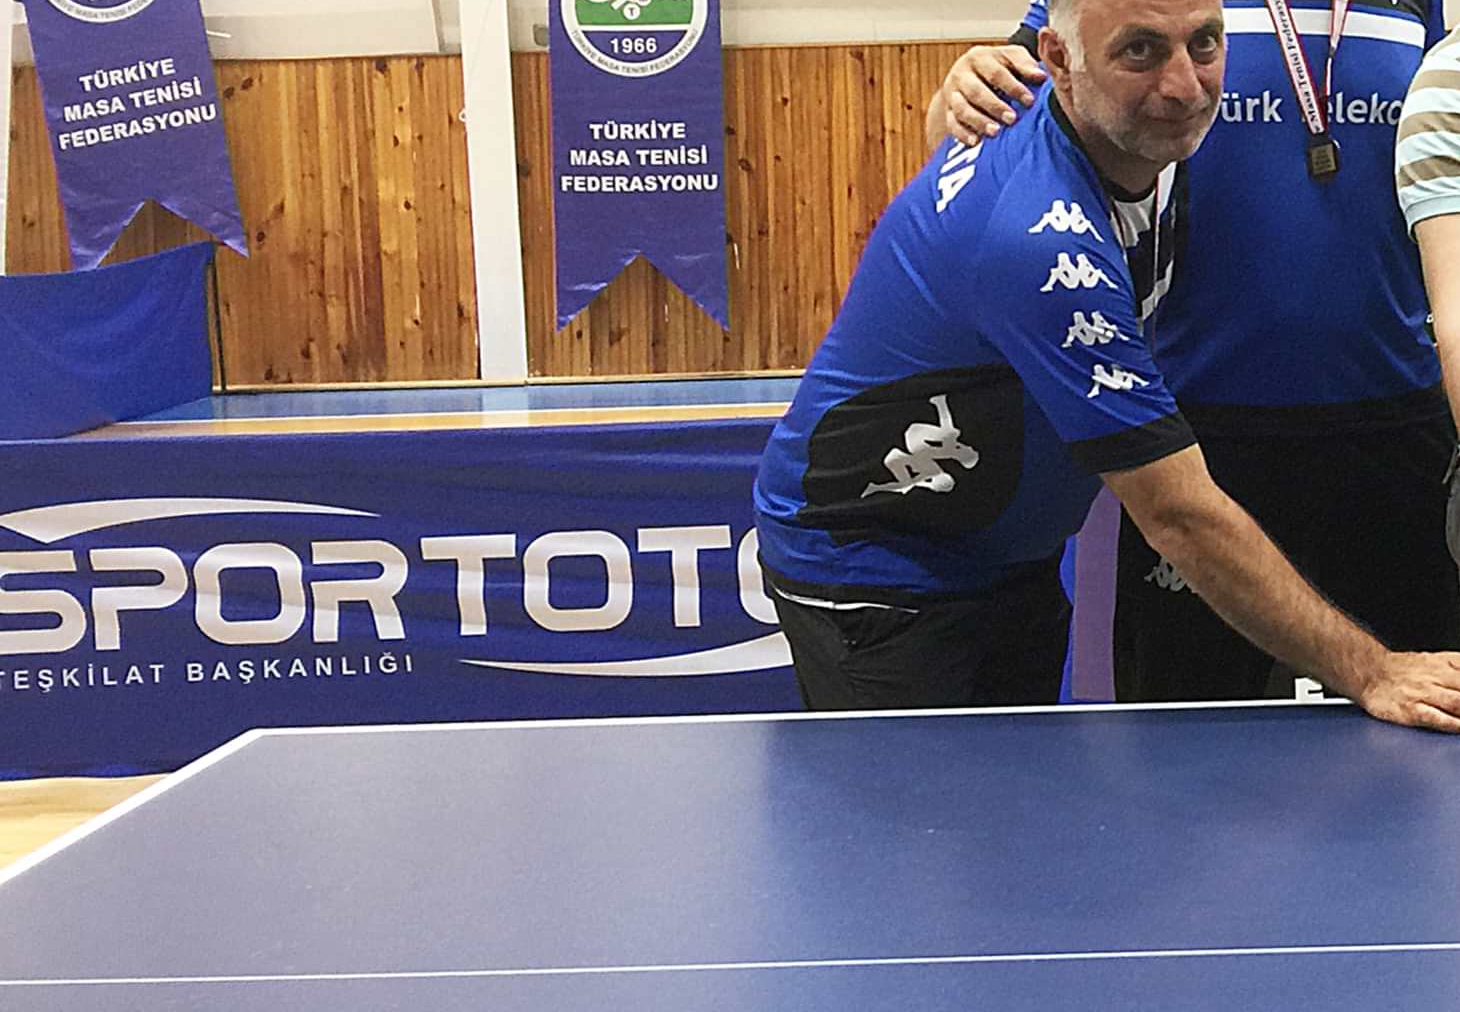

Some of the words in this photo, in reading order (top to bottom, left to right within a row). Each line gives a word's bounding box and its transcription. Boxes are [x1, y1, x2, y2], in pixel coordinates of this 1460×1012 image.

[610, 37, 657, 54] 1966
[79, 57, 175, 92] TÜRKİYE
[63, 93, 126, 123] MASA
[129, 76, 202, 110] TENİSİ
[1221, 91, 1283, 123] ürk
[58, 103, 217, 150] FEDERASYONU
[589, 120, 686, 140] TÜRKİYE
[570, 149, 630, 166] MASA
[636, 145, 708, 166] TENİSİ
[561, 174, 718, 192] FEDERASYONU
[186, 652, 413, 685] BAŞKANLIĞI
